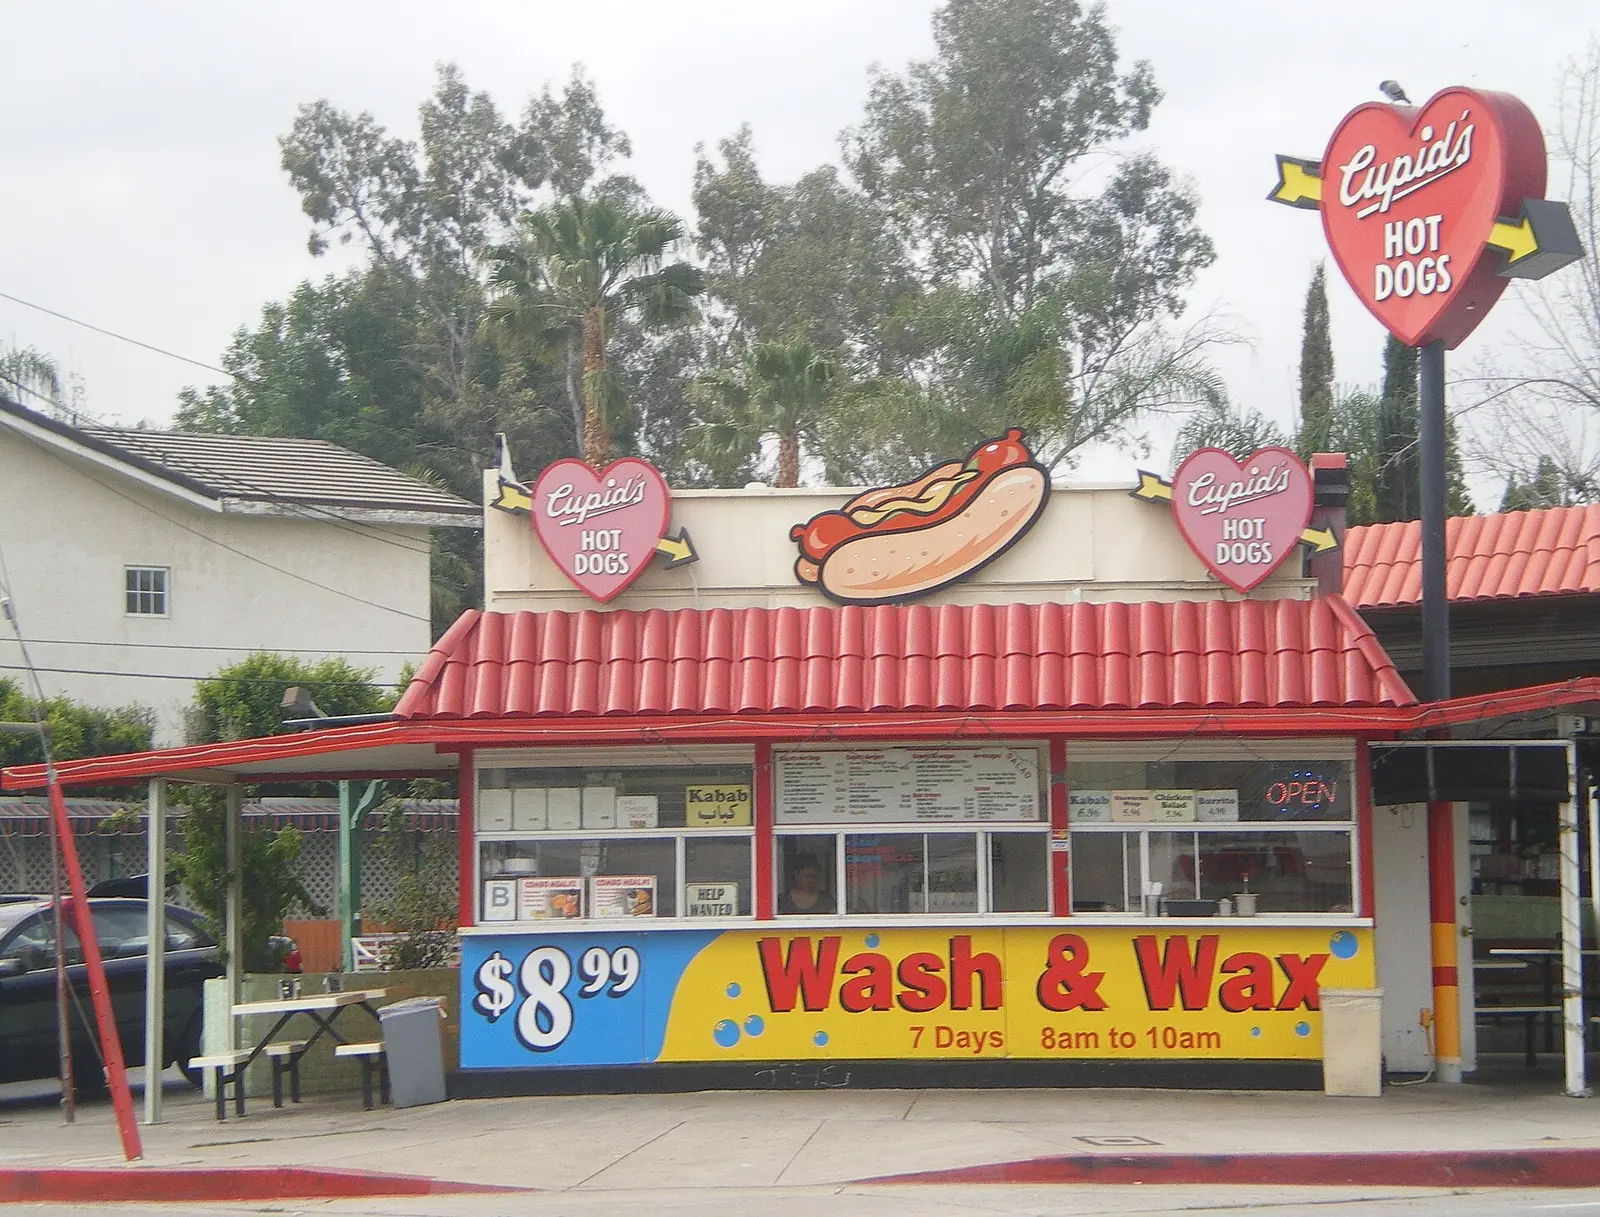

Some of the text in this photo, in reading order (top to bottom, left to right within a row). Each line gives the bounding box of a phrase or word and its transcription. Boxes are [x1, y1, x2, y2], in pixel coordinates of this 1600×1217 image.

[1339, 109, 1475, 219] Cupid's
[1383, 214, 1445, 260] HOT
[1374, 254, 1451, 302] DOGS
[546, 472, 648, 527] Cupid's
[1187, 460, 1292, 516] Cupid's
[580, 529, 624, 552] HOT
[1222, 518, 1267, 541] HOT
[574, 553, 631, 576] DOGS
[1216, 541, 1274, 565] DOGS
[688, 788, 748, 803] Kabab
[1070, 795, 1109, 805] Kabab
[1154, 793, 1192, 802] Chicken
[1264, 780, 1337, 804] OPEN
[492, 886, 509, 907] B
[698, 888, 725, 901] HELP
[690, 904, 732, 917] WANTED
[757, 933, 1331, 1013] Wash & Wax
[909, 1025, 1222, 1054] 7 Days 8am to 10am
